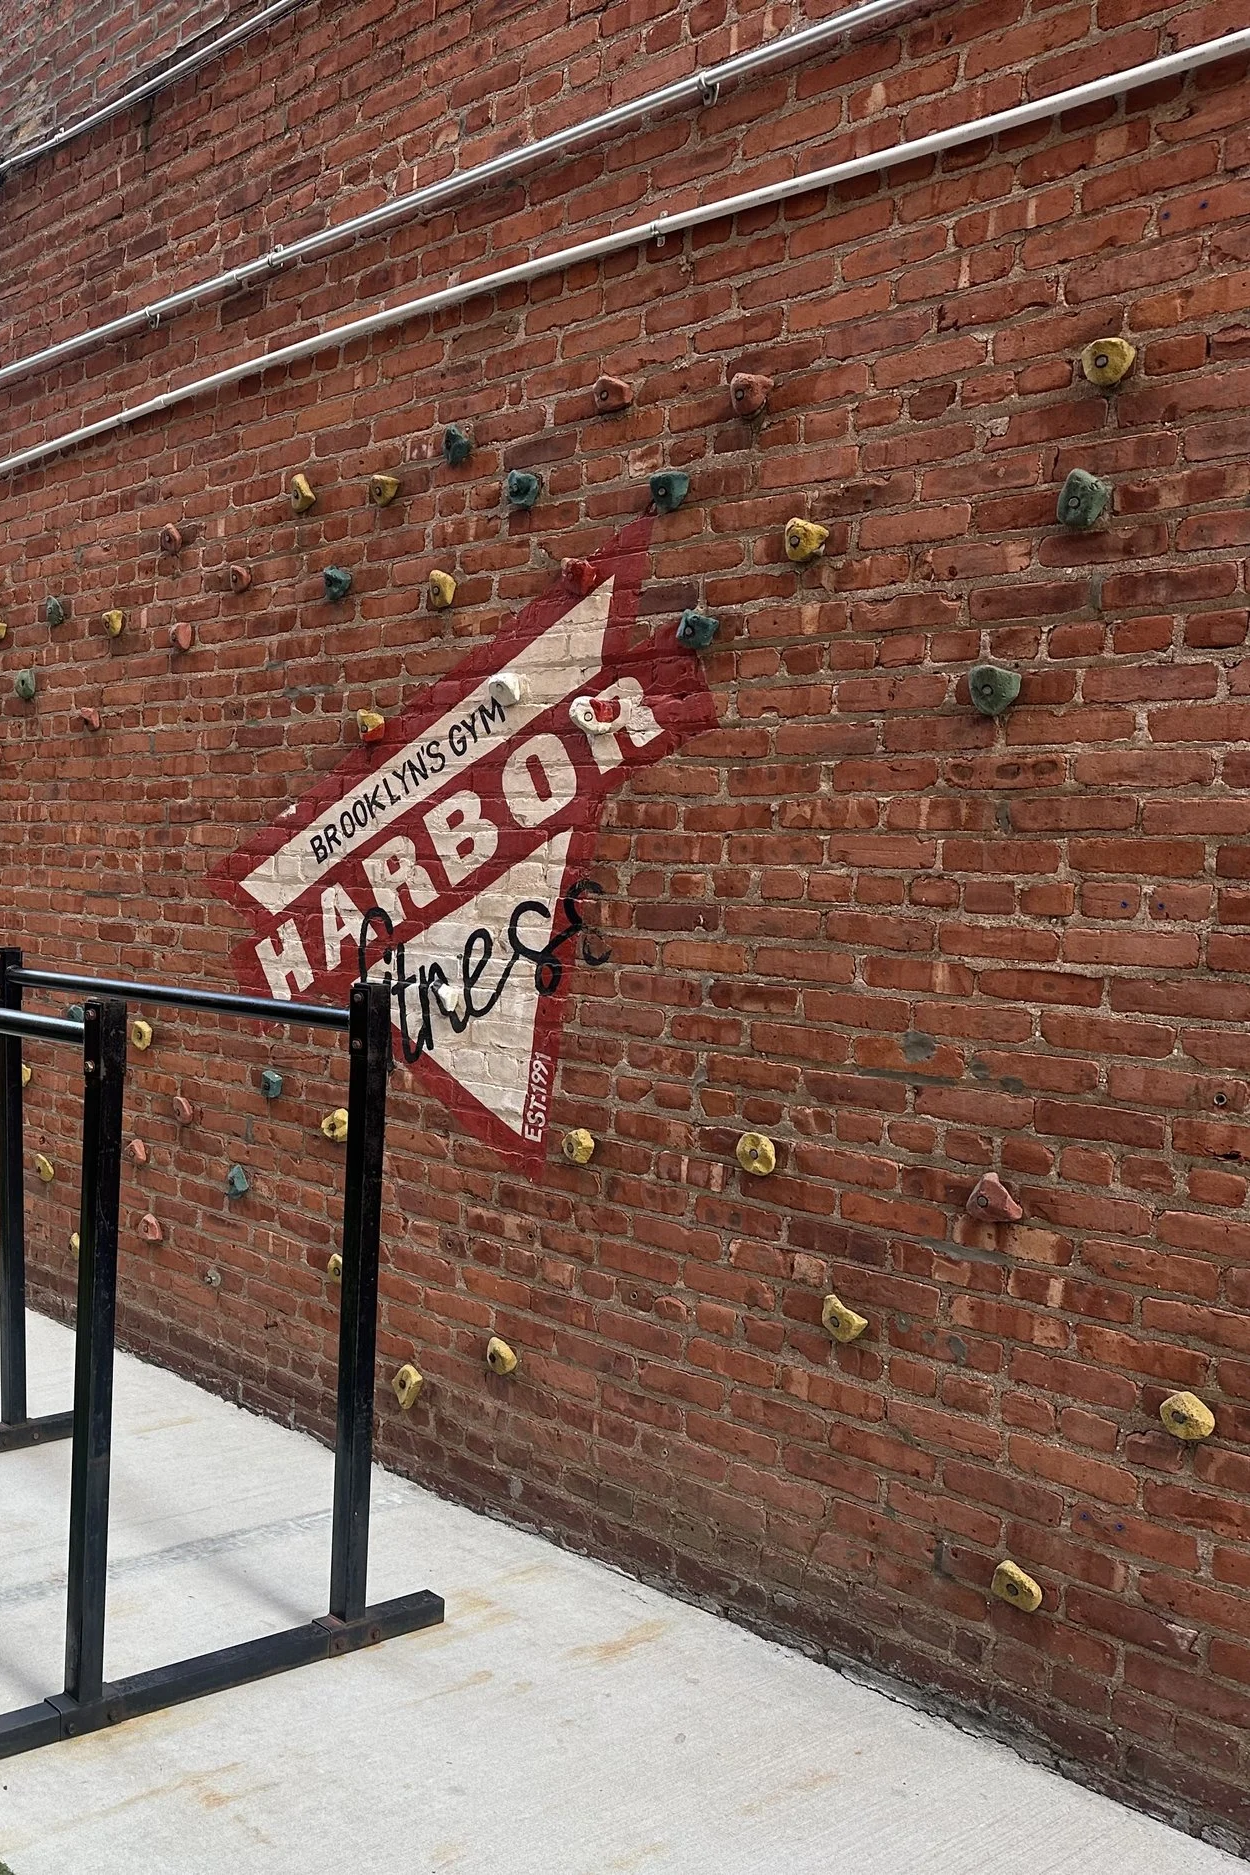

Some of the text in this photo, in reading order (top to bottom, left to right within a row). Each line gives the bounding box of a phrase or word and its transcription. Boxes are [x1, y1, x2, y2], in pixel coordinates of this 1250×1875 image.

[254, 676, 666, 1001] HARBOR
[309, 696, 506, 864] BROOKLYN'S GYM
